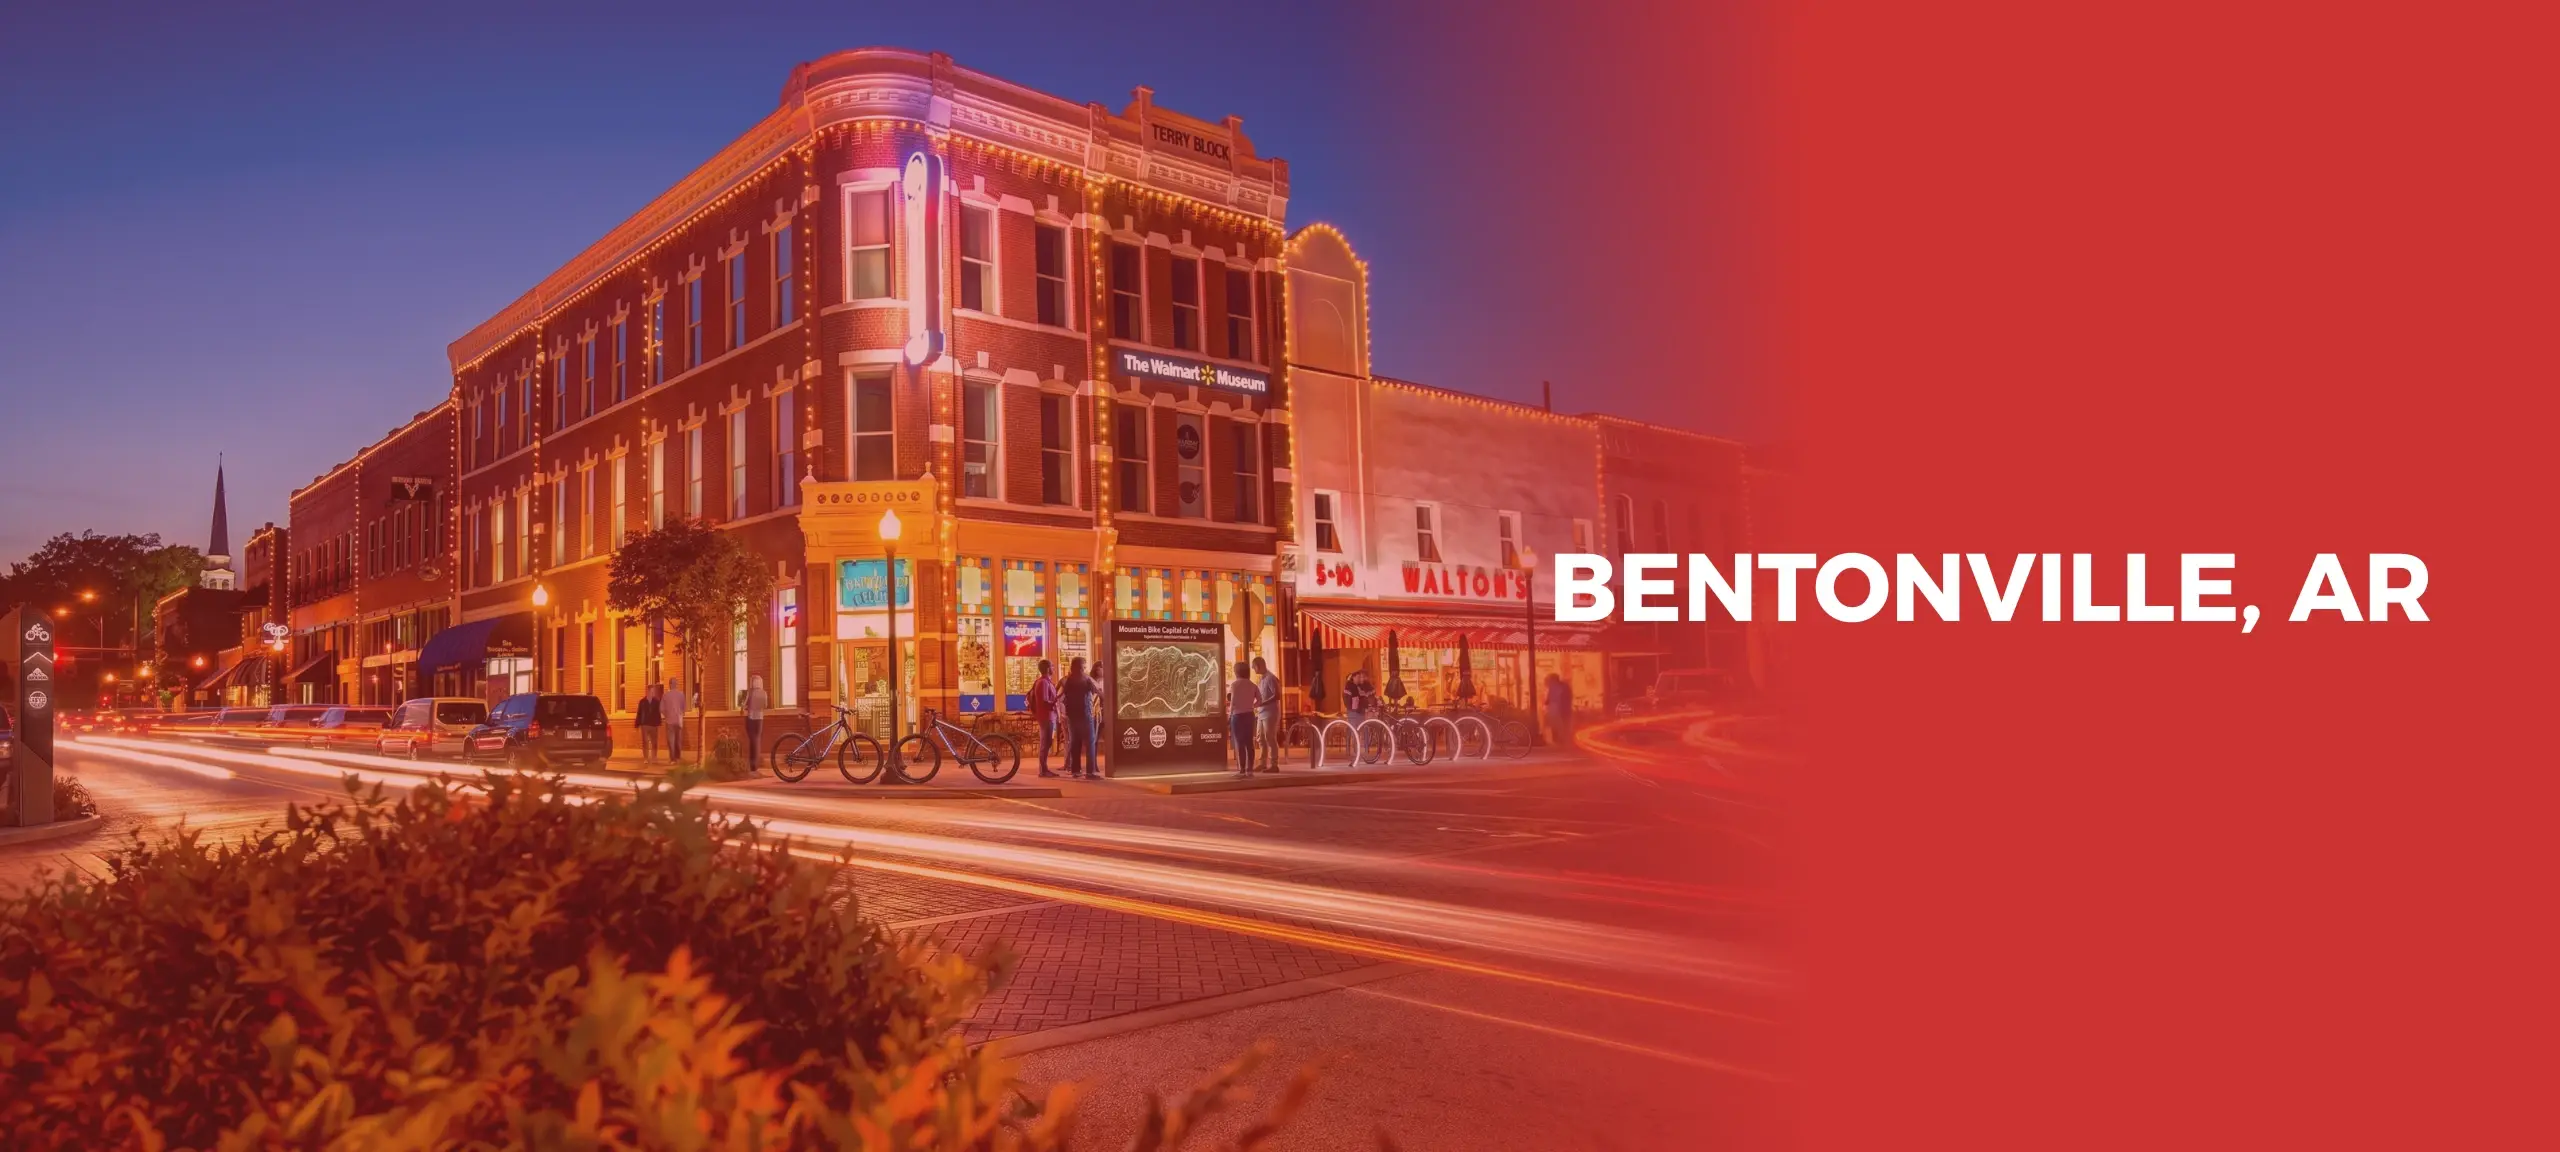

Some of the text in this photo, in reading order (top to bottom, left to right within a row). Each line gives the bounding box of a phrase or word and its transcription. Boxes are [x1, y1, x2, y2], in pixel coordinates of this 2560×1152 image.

[1152, 123, 1229, 160] TERRY BLOCK
[1124, 354, 1266, 392] The Walmart Museum
[1402, 565, 1526, 600] WALTON'S
[1118, 625, 1147, 633] Mountain
[1162, 626, 1182, 635] Capital
[1200, 627, 1218, 635] World
